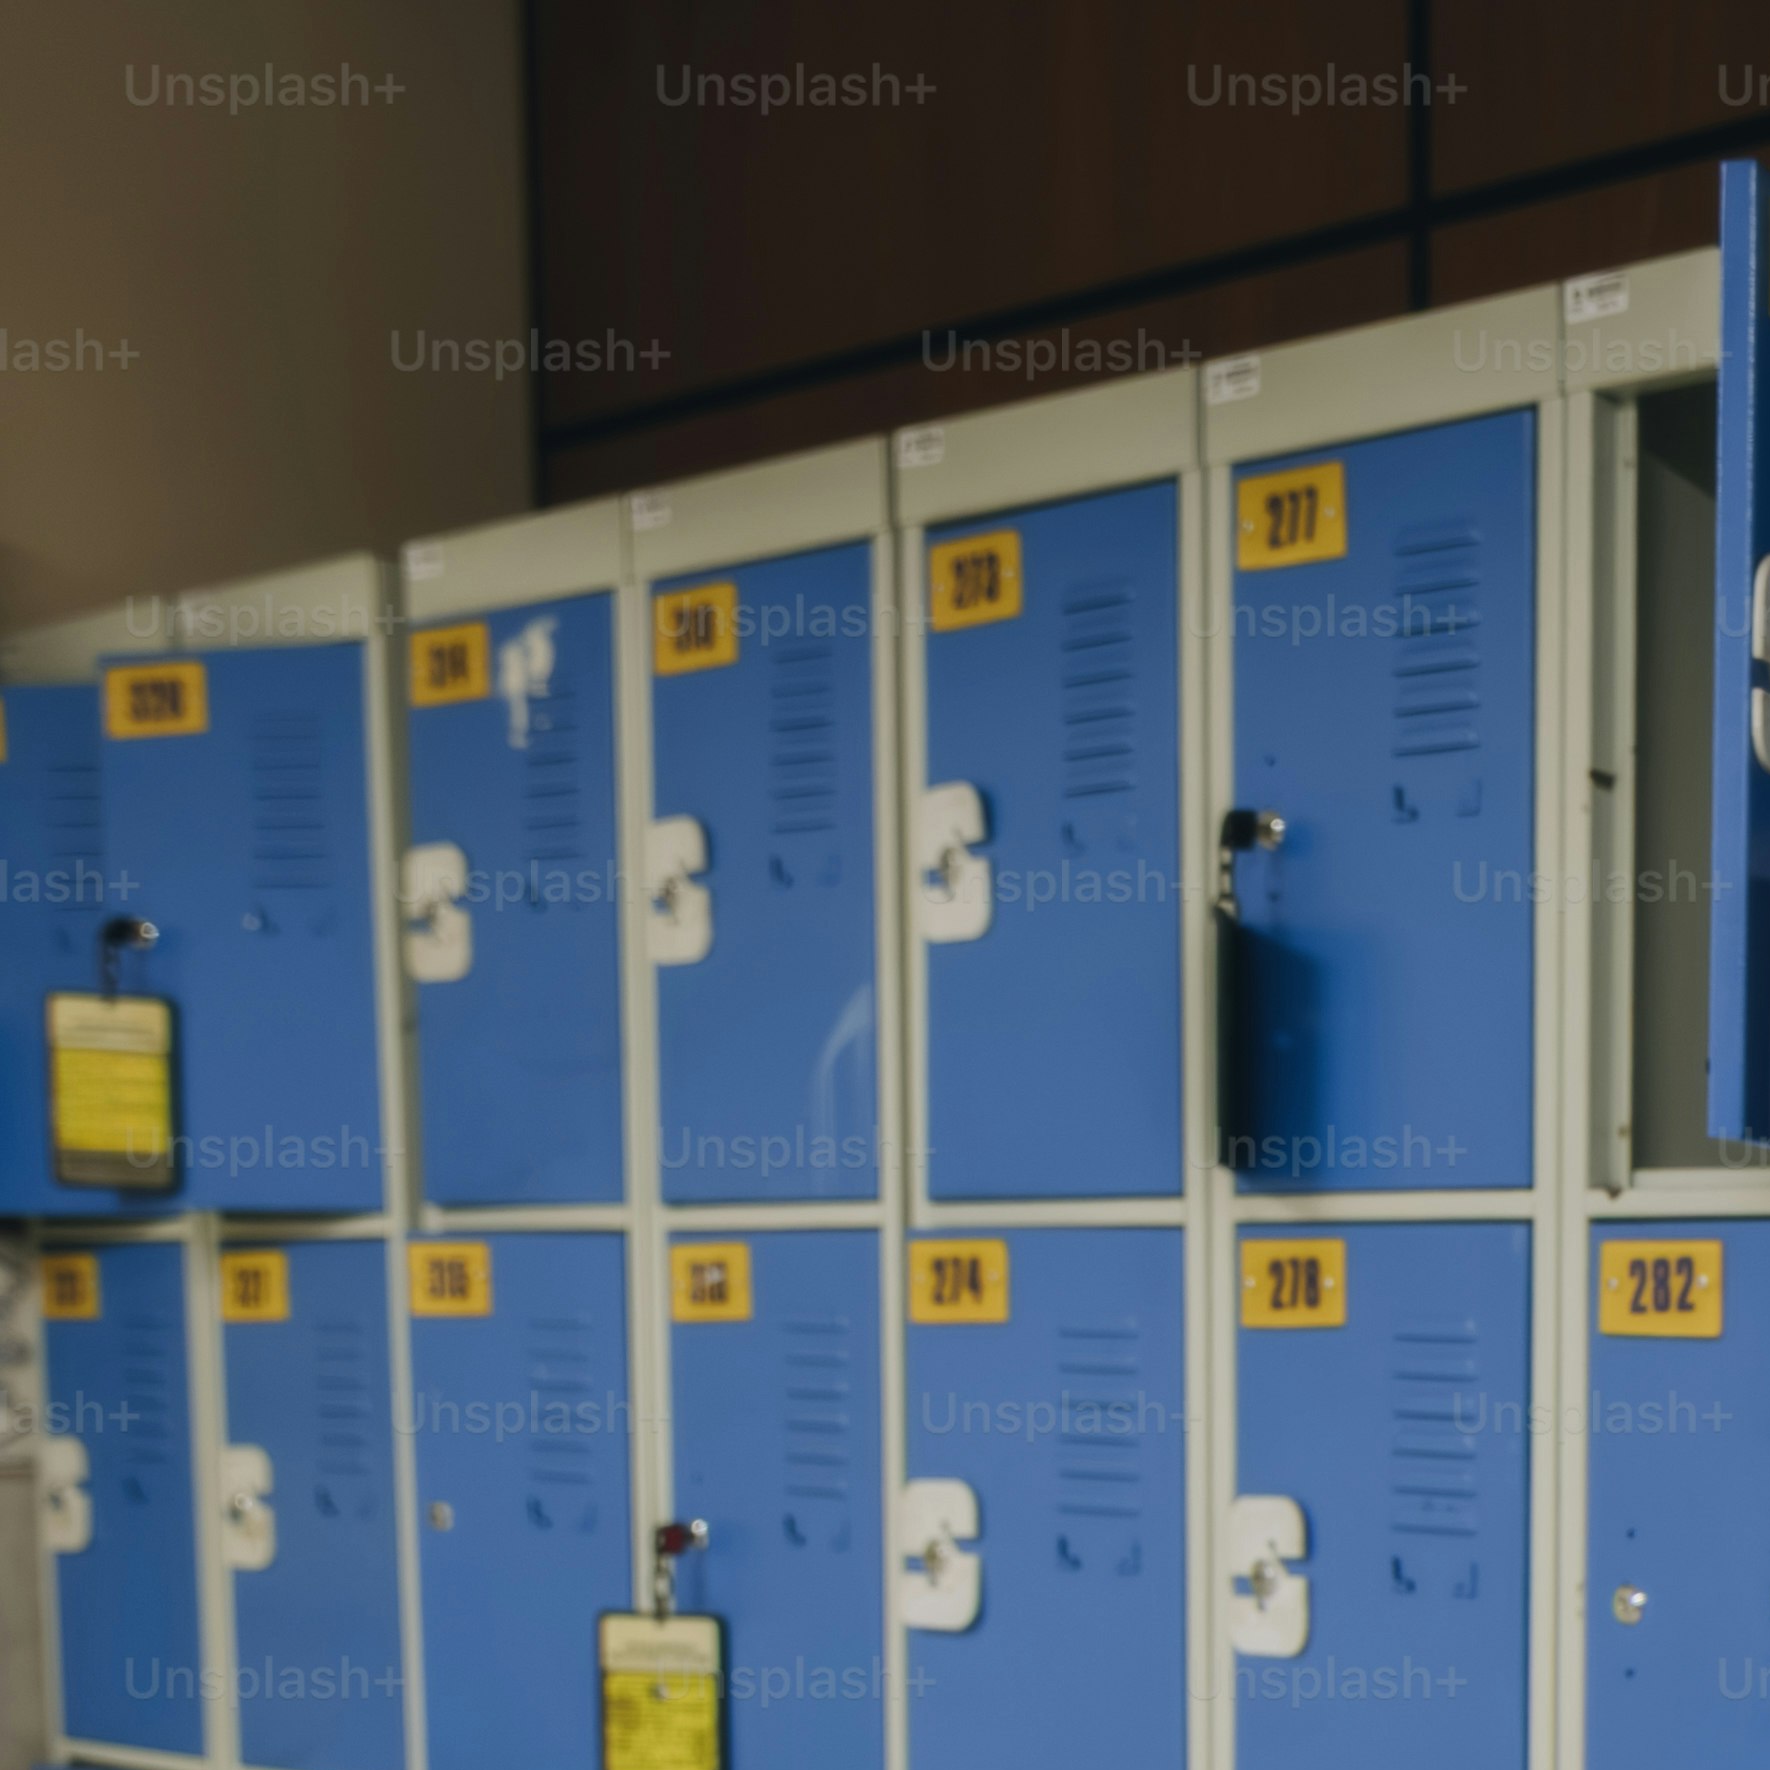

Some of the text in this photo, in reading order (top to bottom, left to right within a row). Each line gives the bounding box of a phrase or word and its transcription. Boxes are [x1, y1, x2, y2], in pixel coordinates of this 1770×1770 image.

[1264, 484, 1319, 549] 277
[931, 1257, 982, 1305] 274
[1269, 1257, 1320, 1310] 278
[1630, 1256, 1694, 1314] 282
